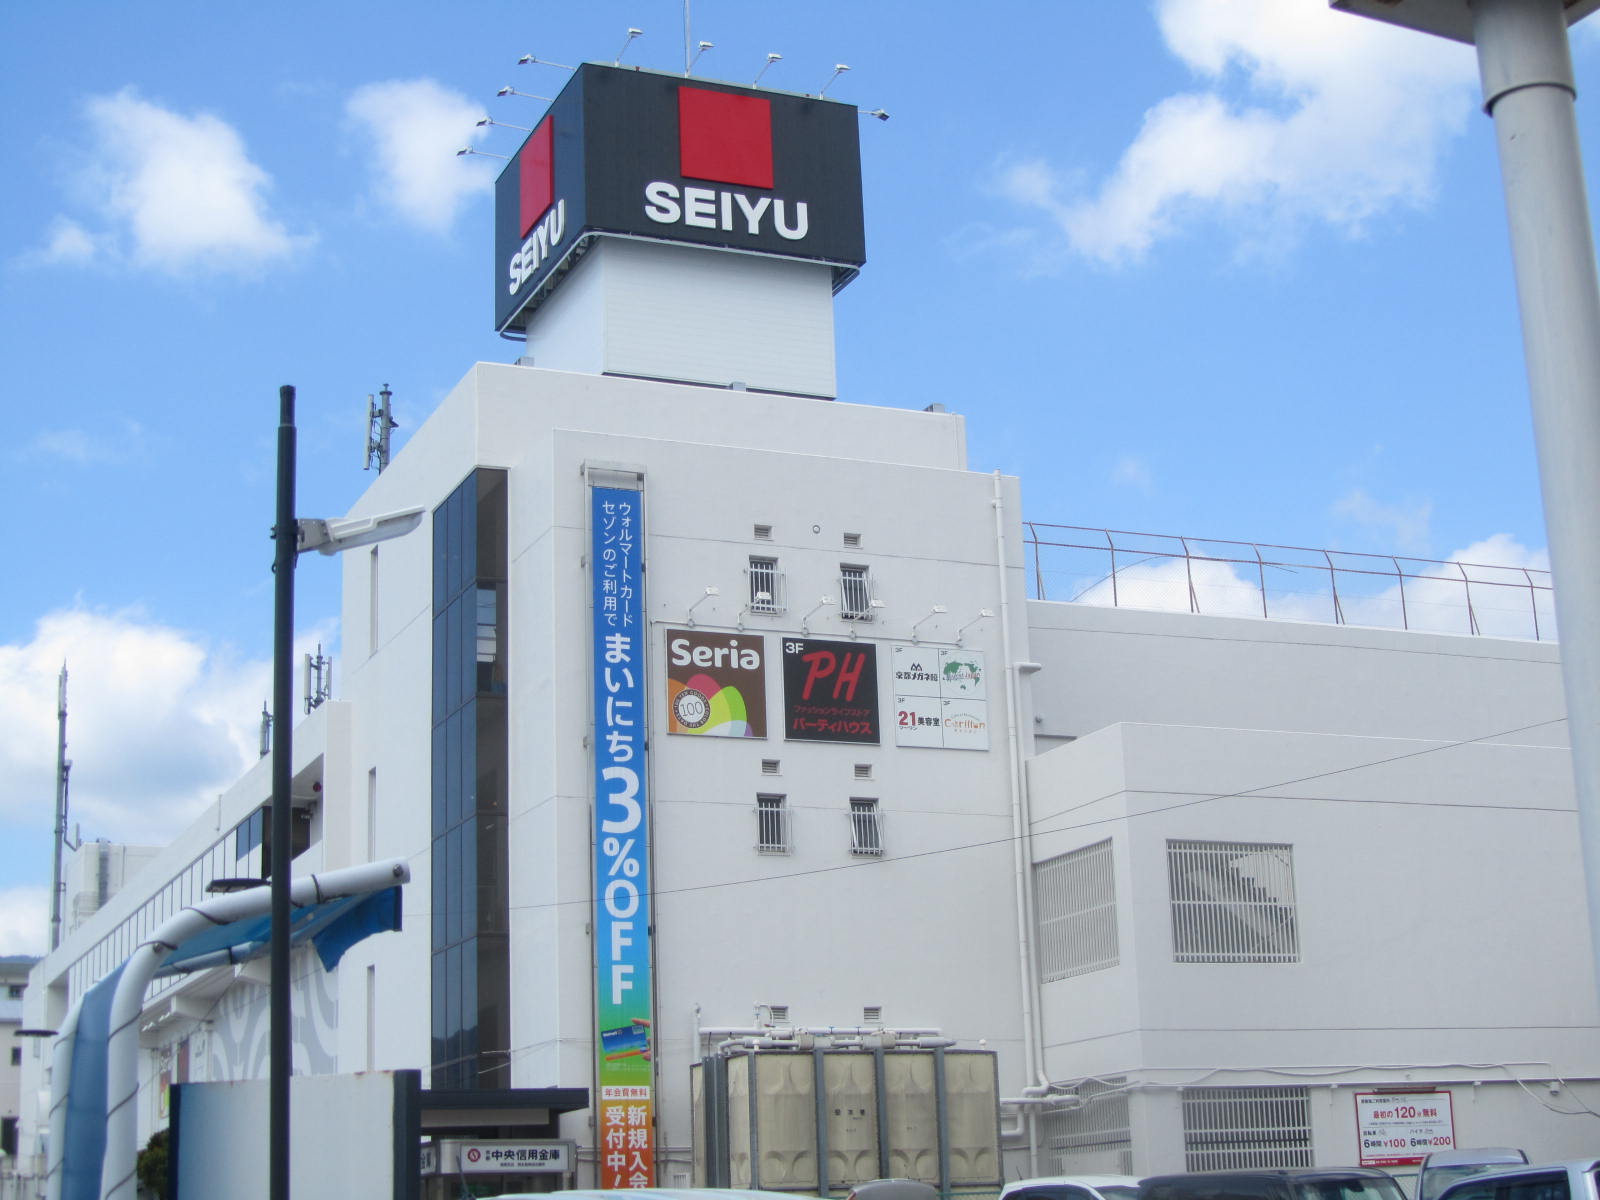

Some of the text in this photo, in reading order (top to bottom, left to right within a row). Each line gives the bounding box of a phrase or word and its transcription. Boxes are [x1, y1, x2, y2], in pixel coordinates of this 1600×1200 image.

[645, 181, 809, 240] SEIYU
[509, 199, 566, 295] SEIYU
[602, 500, 618, 626] セゾンのご利用で
[619, 501, 633, 628] ウォルマートカード
[671, 638, 760, 670] Seria
[785, 642, 804, 654] 3F
[802, 651, 865, 701] PH
[604, 632, 635, 762] まいにち
[680, 701, 704, 716] 100
[628, 1105, 649, 1189] 新規入会
